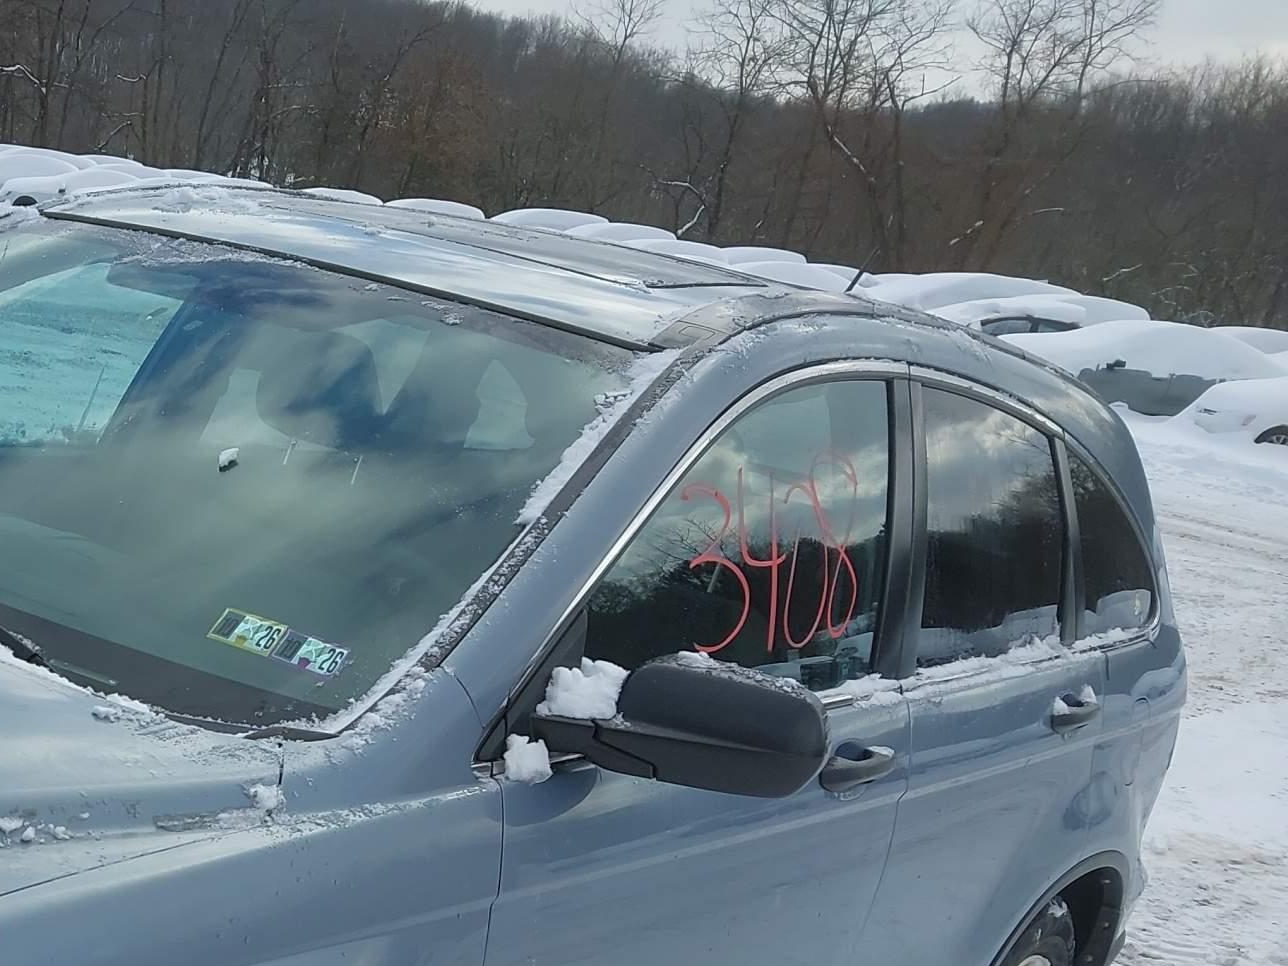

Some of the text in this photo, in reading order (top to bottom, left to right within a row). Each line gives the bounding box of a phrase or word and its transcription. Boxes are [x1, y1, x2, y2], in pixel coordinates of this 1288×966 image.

[680, 452, 858, 654] 3408
[255, 625, 282, 650] 26
[317, 648, 345, 674] 26
